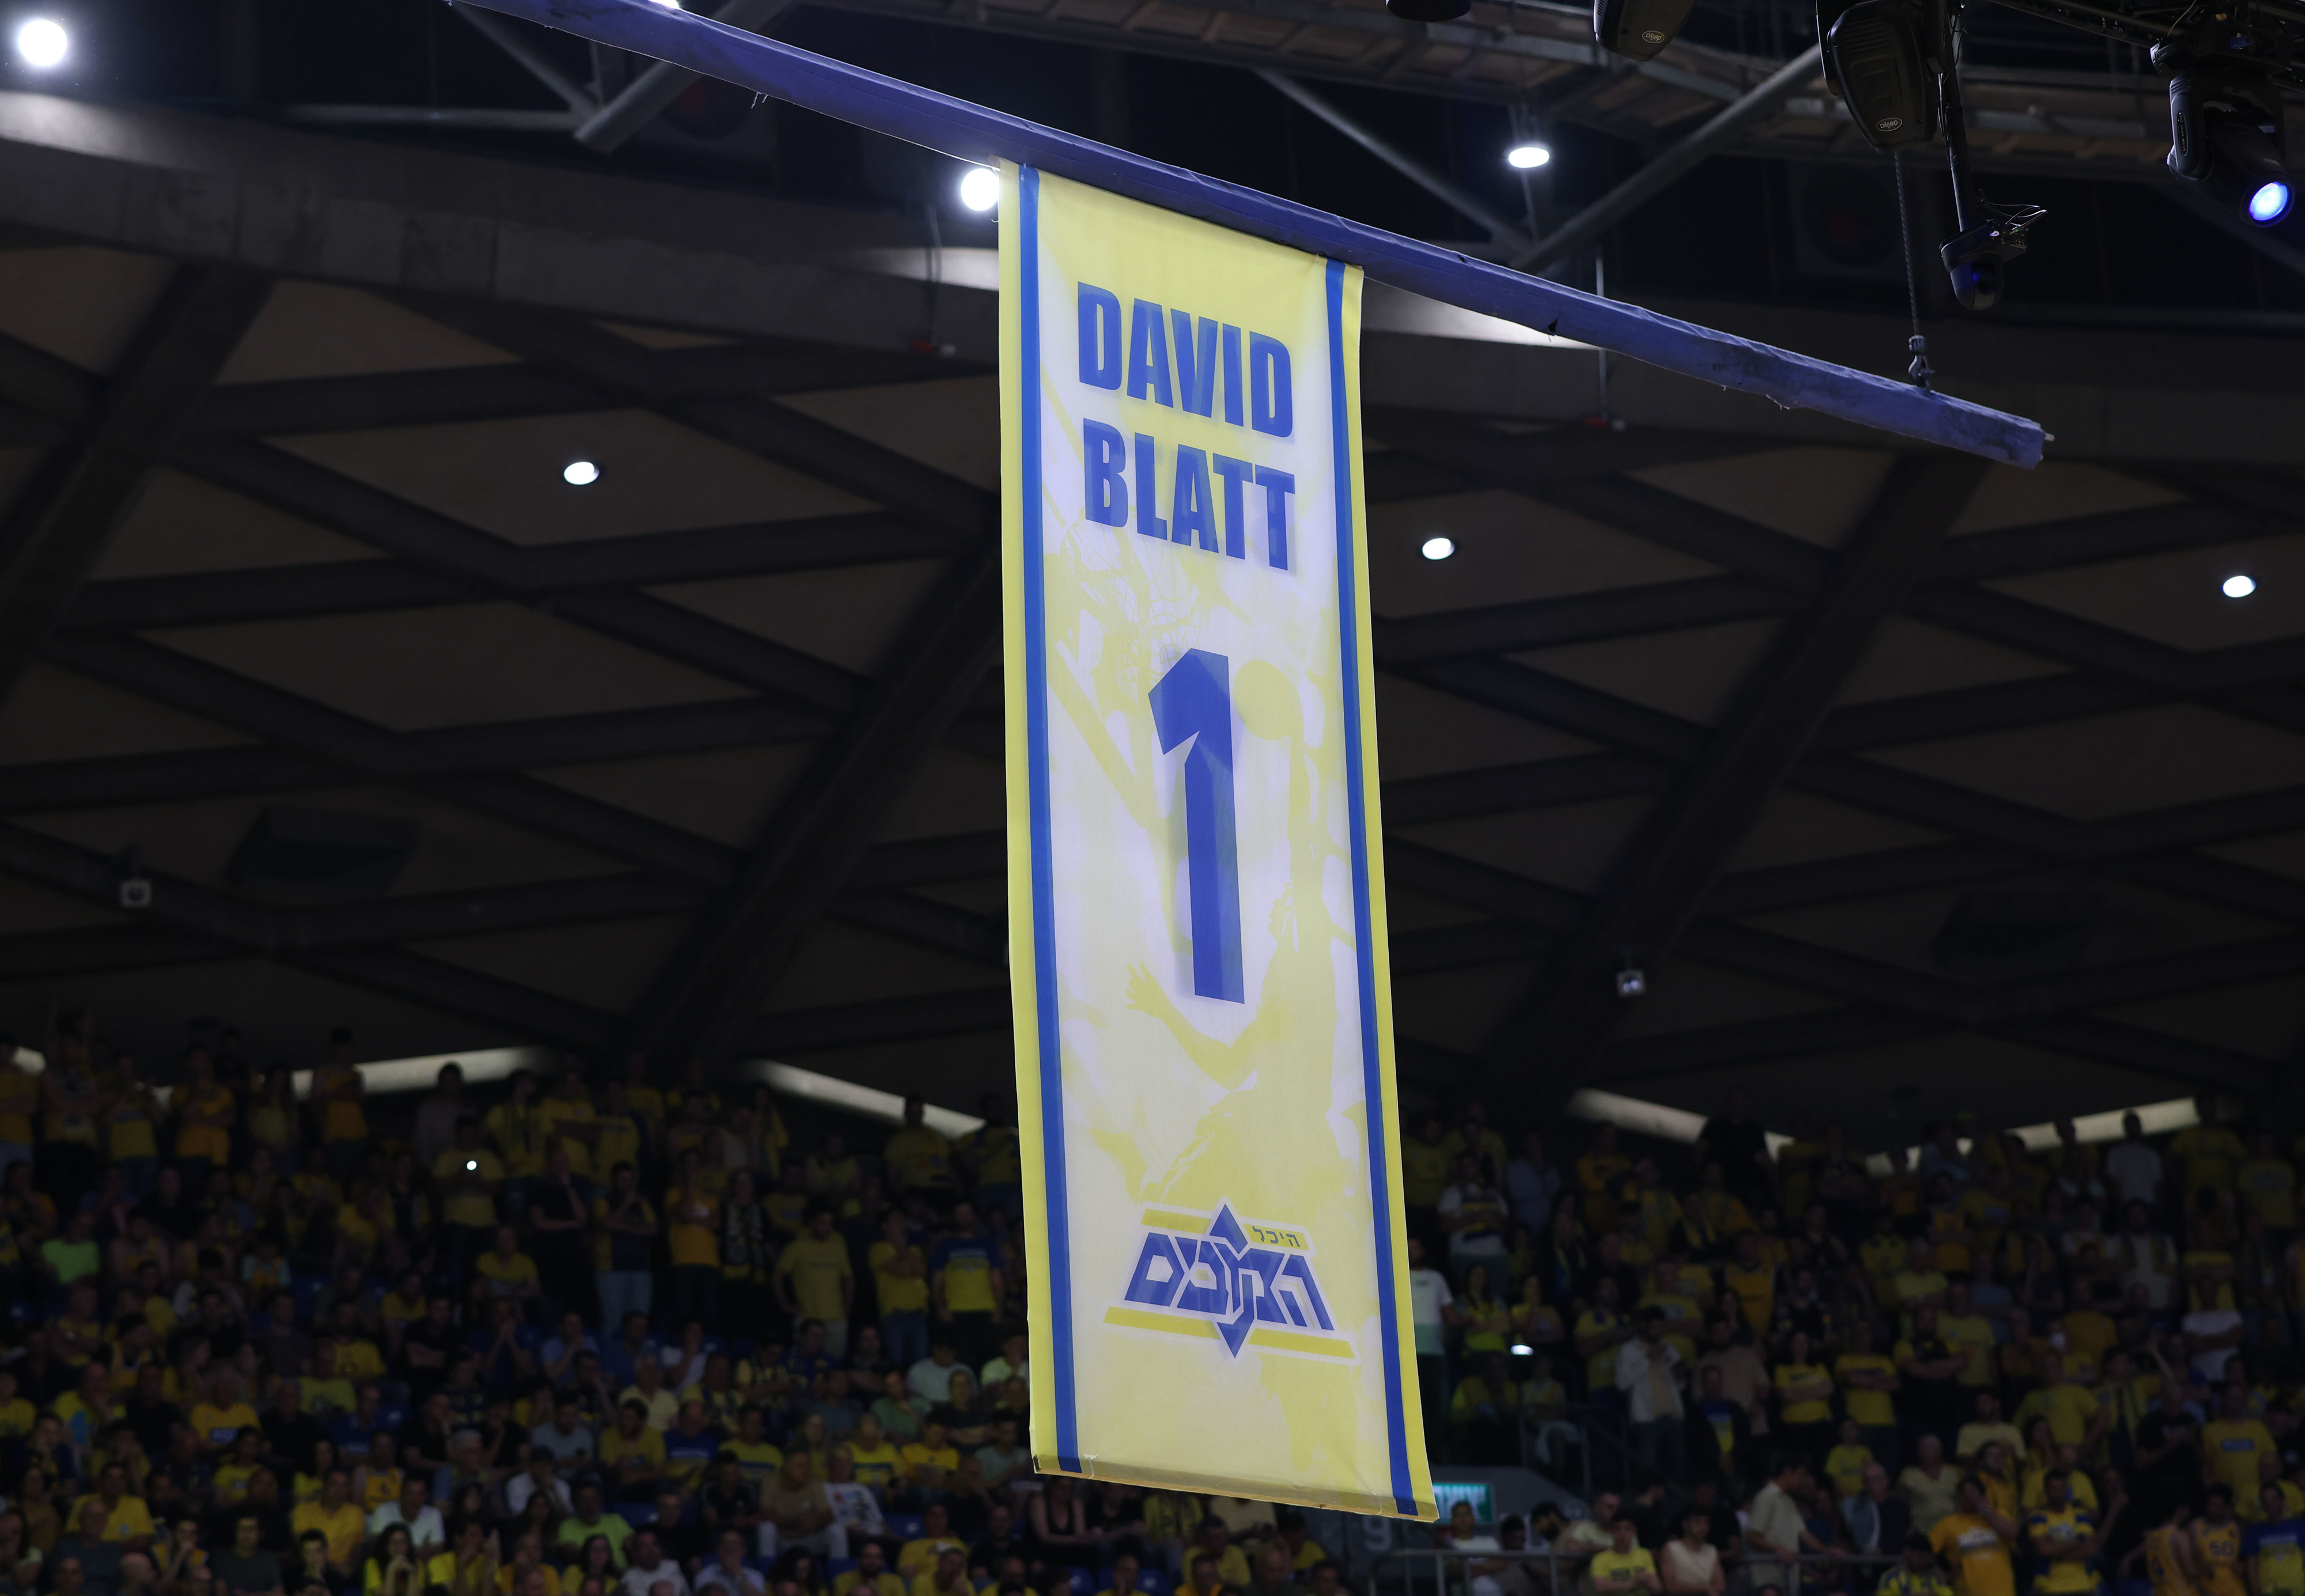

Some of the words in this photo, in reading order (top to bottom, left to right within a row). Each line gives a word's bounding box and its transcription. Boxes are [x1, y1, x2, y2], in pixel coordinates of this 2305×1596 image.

[1880, 120, 1898, 128] deliya
[1077, 281, 1294, 438] DAVID
[1083, 418, 1295, 571] BLATT
[1148, 648, 1245, 1004] 1
[1252, 1226, 1301, 1247] היכל
